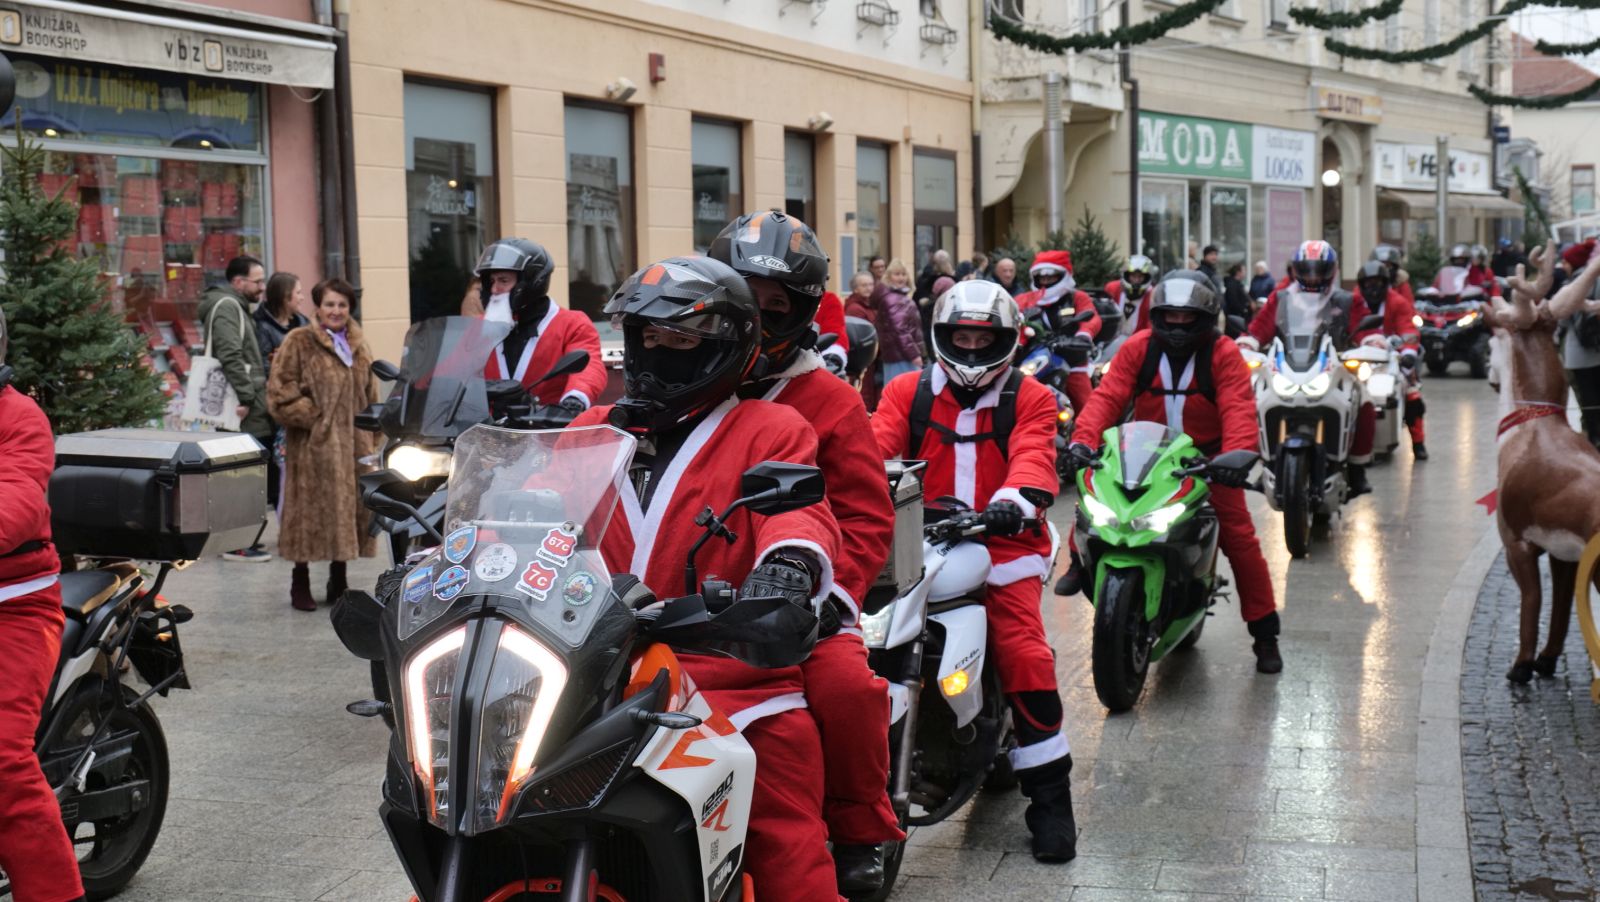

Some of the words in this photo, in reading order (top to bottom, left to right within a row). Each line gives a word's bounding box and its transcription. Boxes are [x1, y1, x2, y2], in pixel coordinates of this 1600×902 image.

[25, 14, 80, 34] KNJIŽARA
[26, 34, 87, 51] BOOKSHOP
[225, 44, 268, 60] KNJIŽARA
[225, 60, 273, 74] BOOKSHOP
[1138, 117, 1244, 169] MODA
[1265, 156, 1304, 180] LOGOS
[1420, 153, 1456, 177] FEX
[701, 769, 734, 817] 1290
